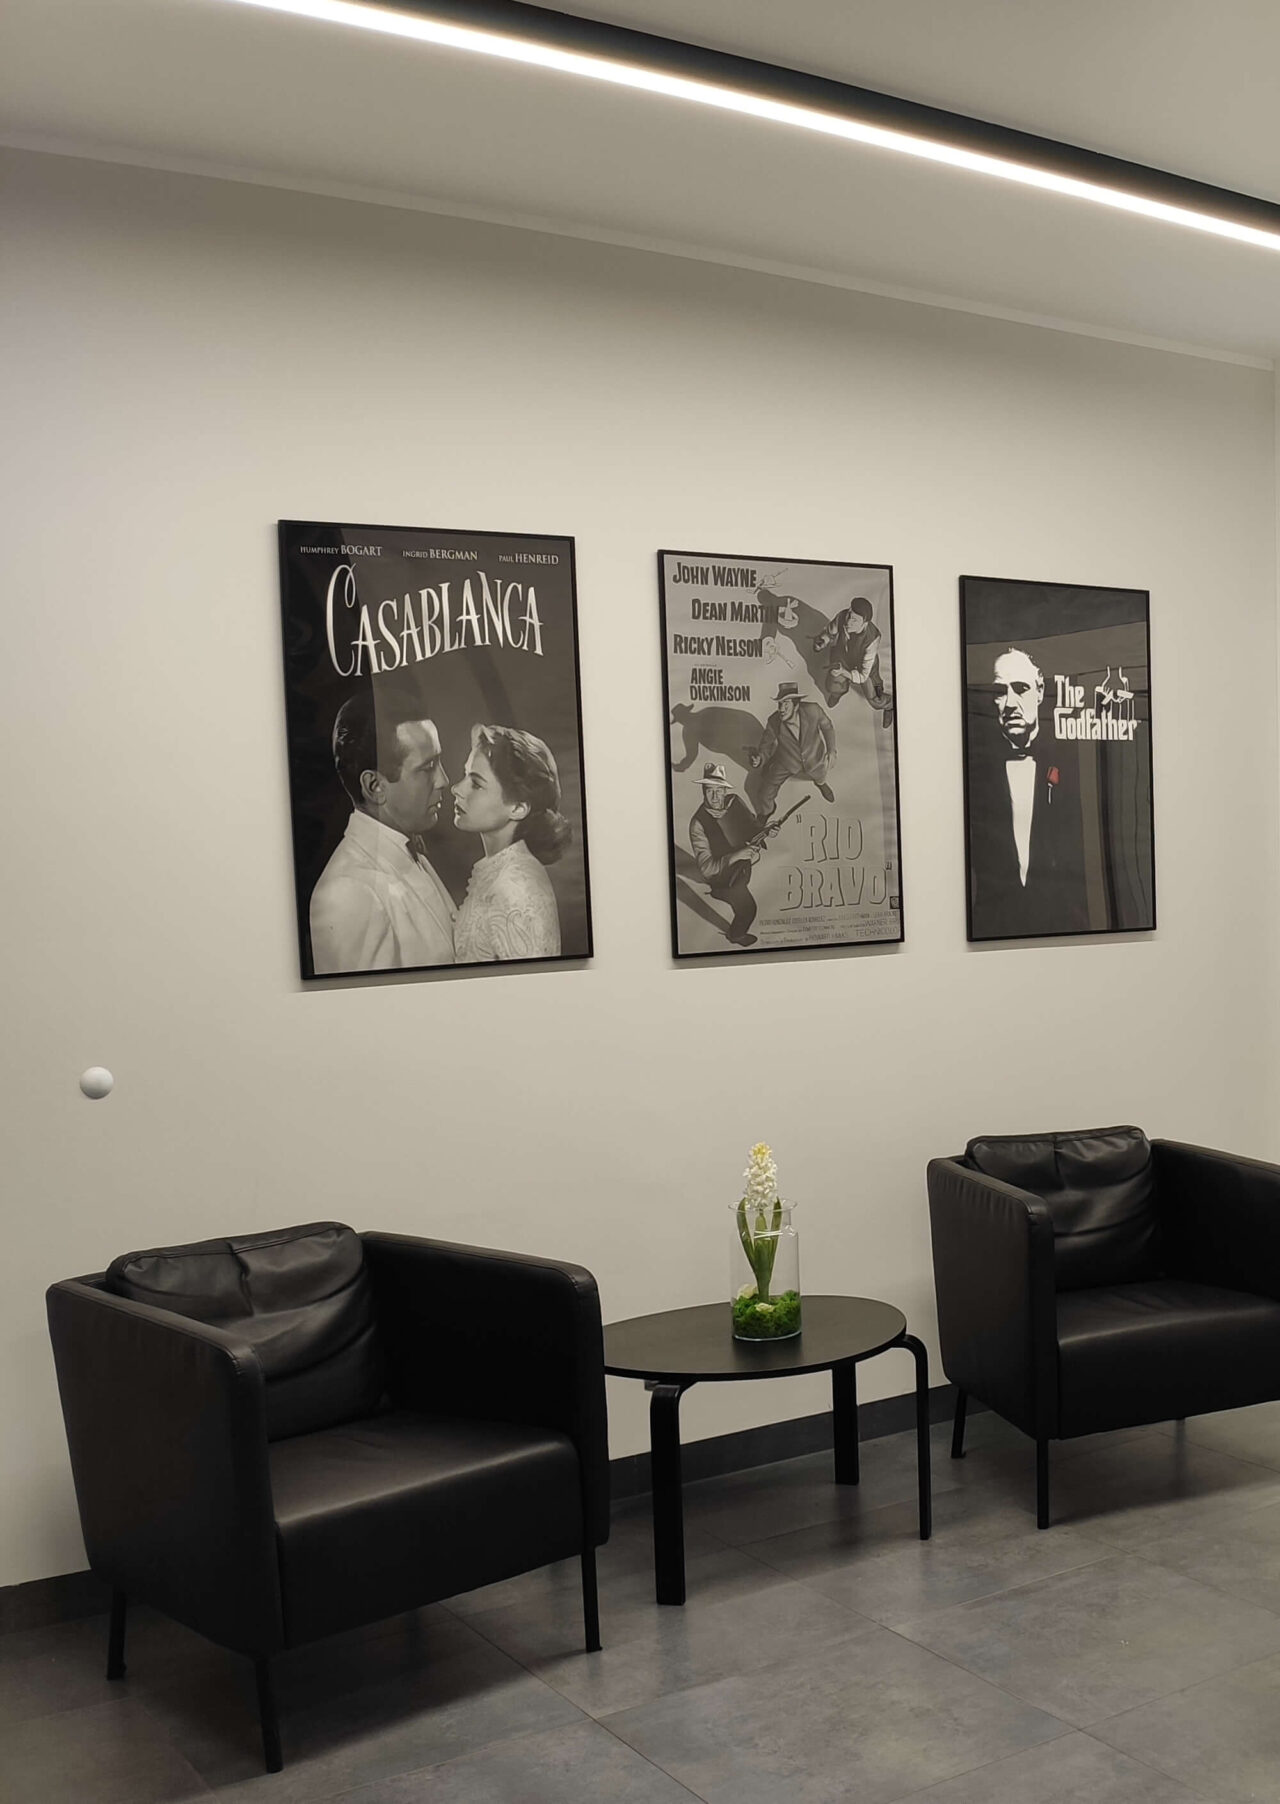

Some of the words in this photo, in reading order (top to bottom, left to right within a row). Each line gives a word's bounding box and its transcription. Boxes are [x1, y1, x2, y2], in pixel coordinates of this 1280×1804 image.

[300, 545, 340, 555] HUMPHREY
[341, 545, 383, 556] BOGART
[402, 550, 428, 558] INGRID
[429, 549, 478, 560] BERGMAN
[499, 555, 514, 563] PAUL
[515, 553, 559, 565] HENREID
[672, 562, 710, 585] JOHN
[712, 565, 757, 588] WAYNE
[326, 562, 544, 677] CASABLANCA
[691, 598, 728, 621] DEAN
[673, 634, 714, 656] RICKY
[715, 635, 763, 658] NELSON
[690, 668, 724, 685] ANGIE
[690, 685, 751, 702] DICKINSON
[1054, 674, 1085, 708] The
[1053, 707, 1138, 741] Godfather
